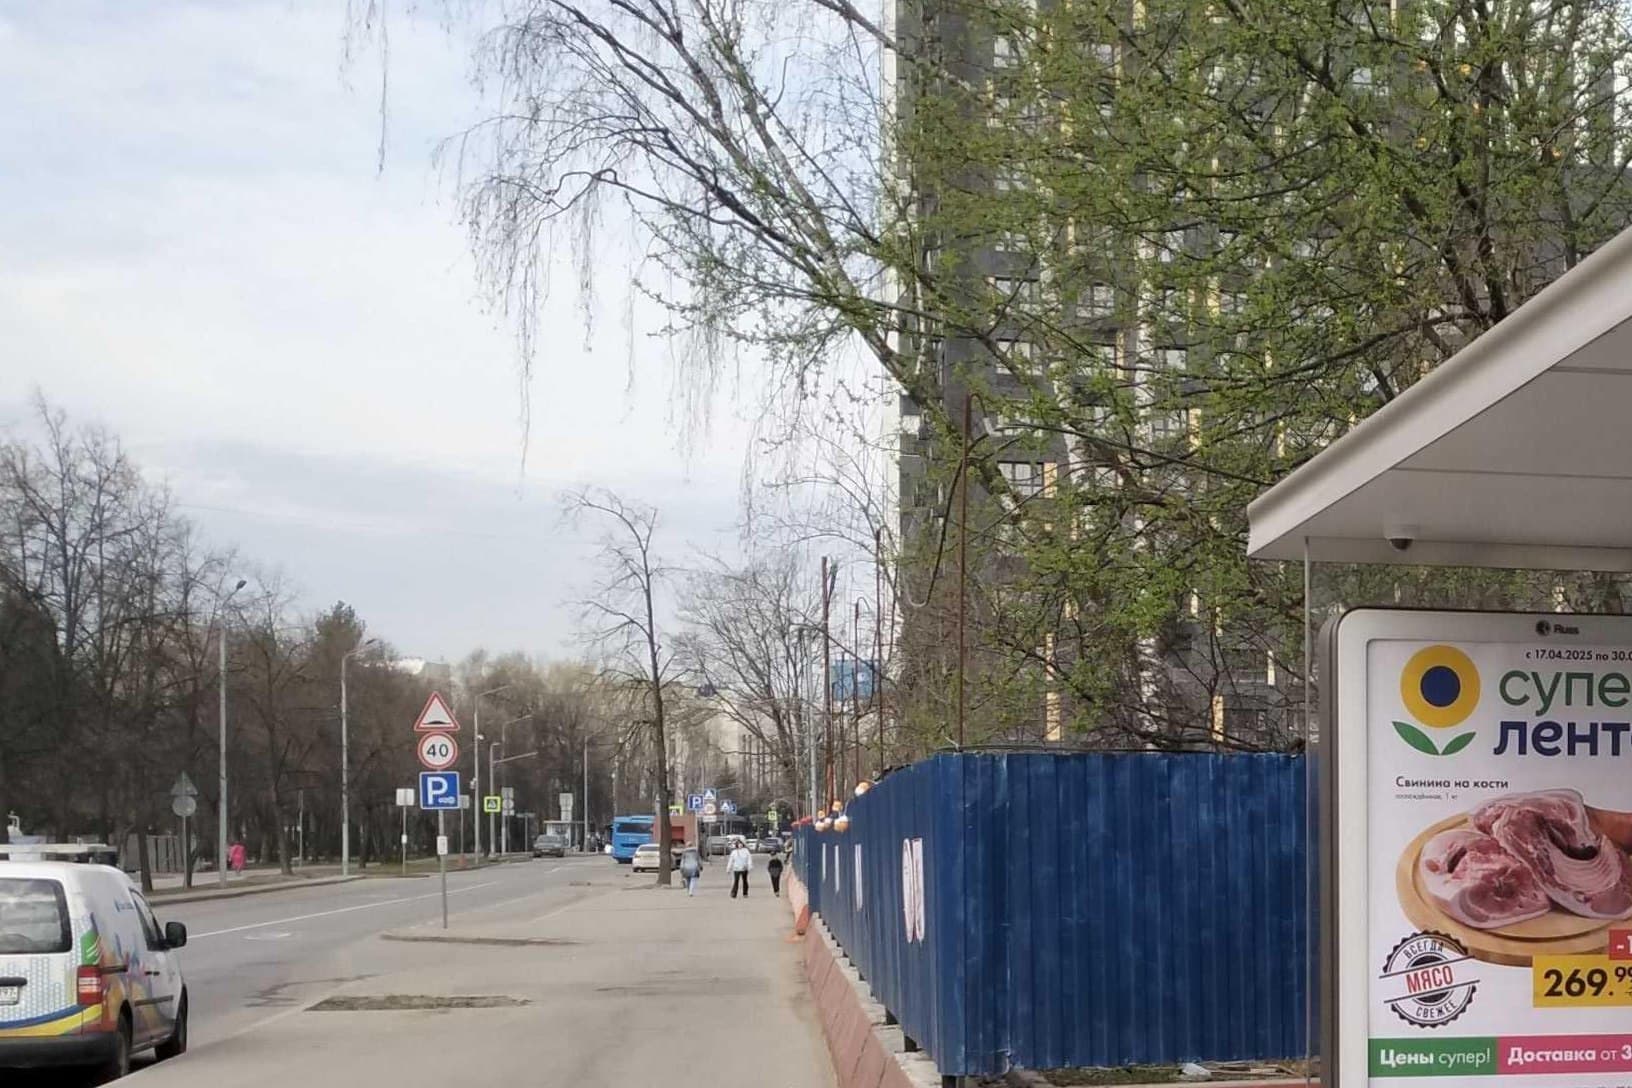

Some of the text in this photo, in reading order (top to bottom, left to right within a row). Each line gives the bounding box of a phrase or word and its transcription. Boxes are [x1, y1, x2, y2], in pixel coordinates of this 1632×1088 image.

[1535, 649, 1593, 660] 17.04.2025
[426, 743, 449, 758] 40
[427, 776, 448, 806] P
[1395, 775, 1509, 789] Свинина на кости
[1402, 939, 1445, 960] ВСЕГДА
[1405, 964, 1454, 994] МЯСО
[1415, 998, 1458, 1019] СВЕЖЕЕ
[1380, 1047, 1491, 1069] Цены супер!
[1507, 1046, 1596, 1066] Доставка
[1600, 1050, 1617, 1061] от
